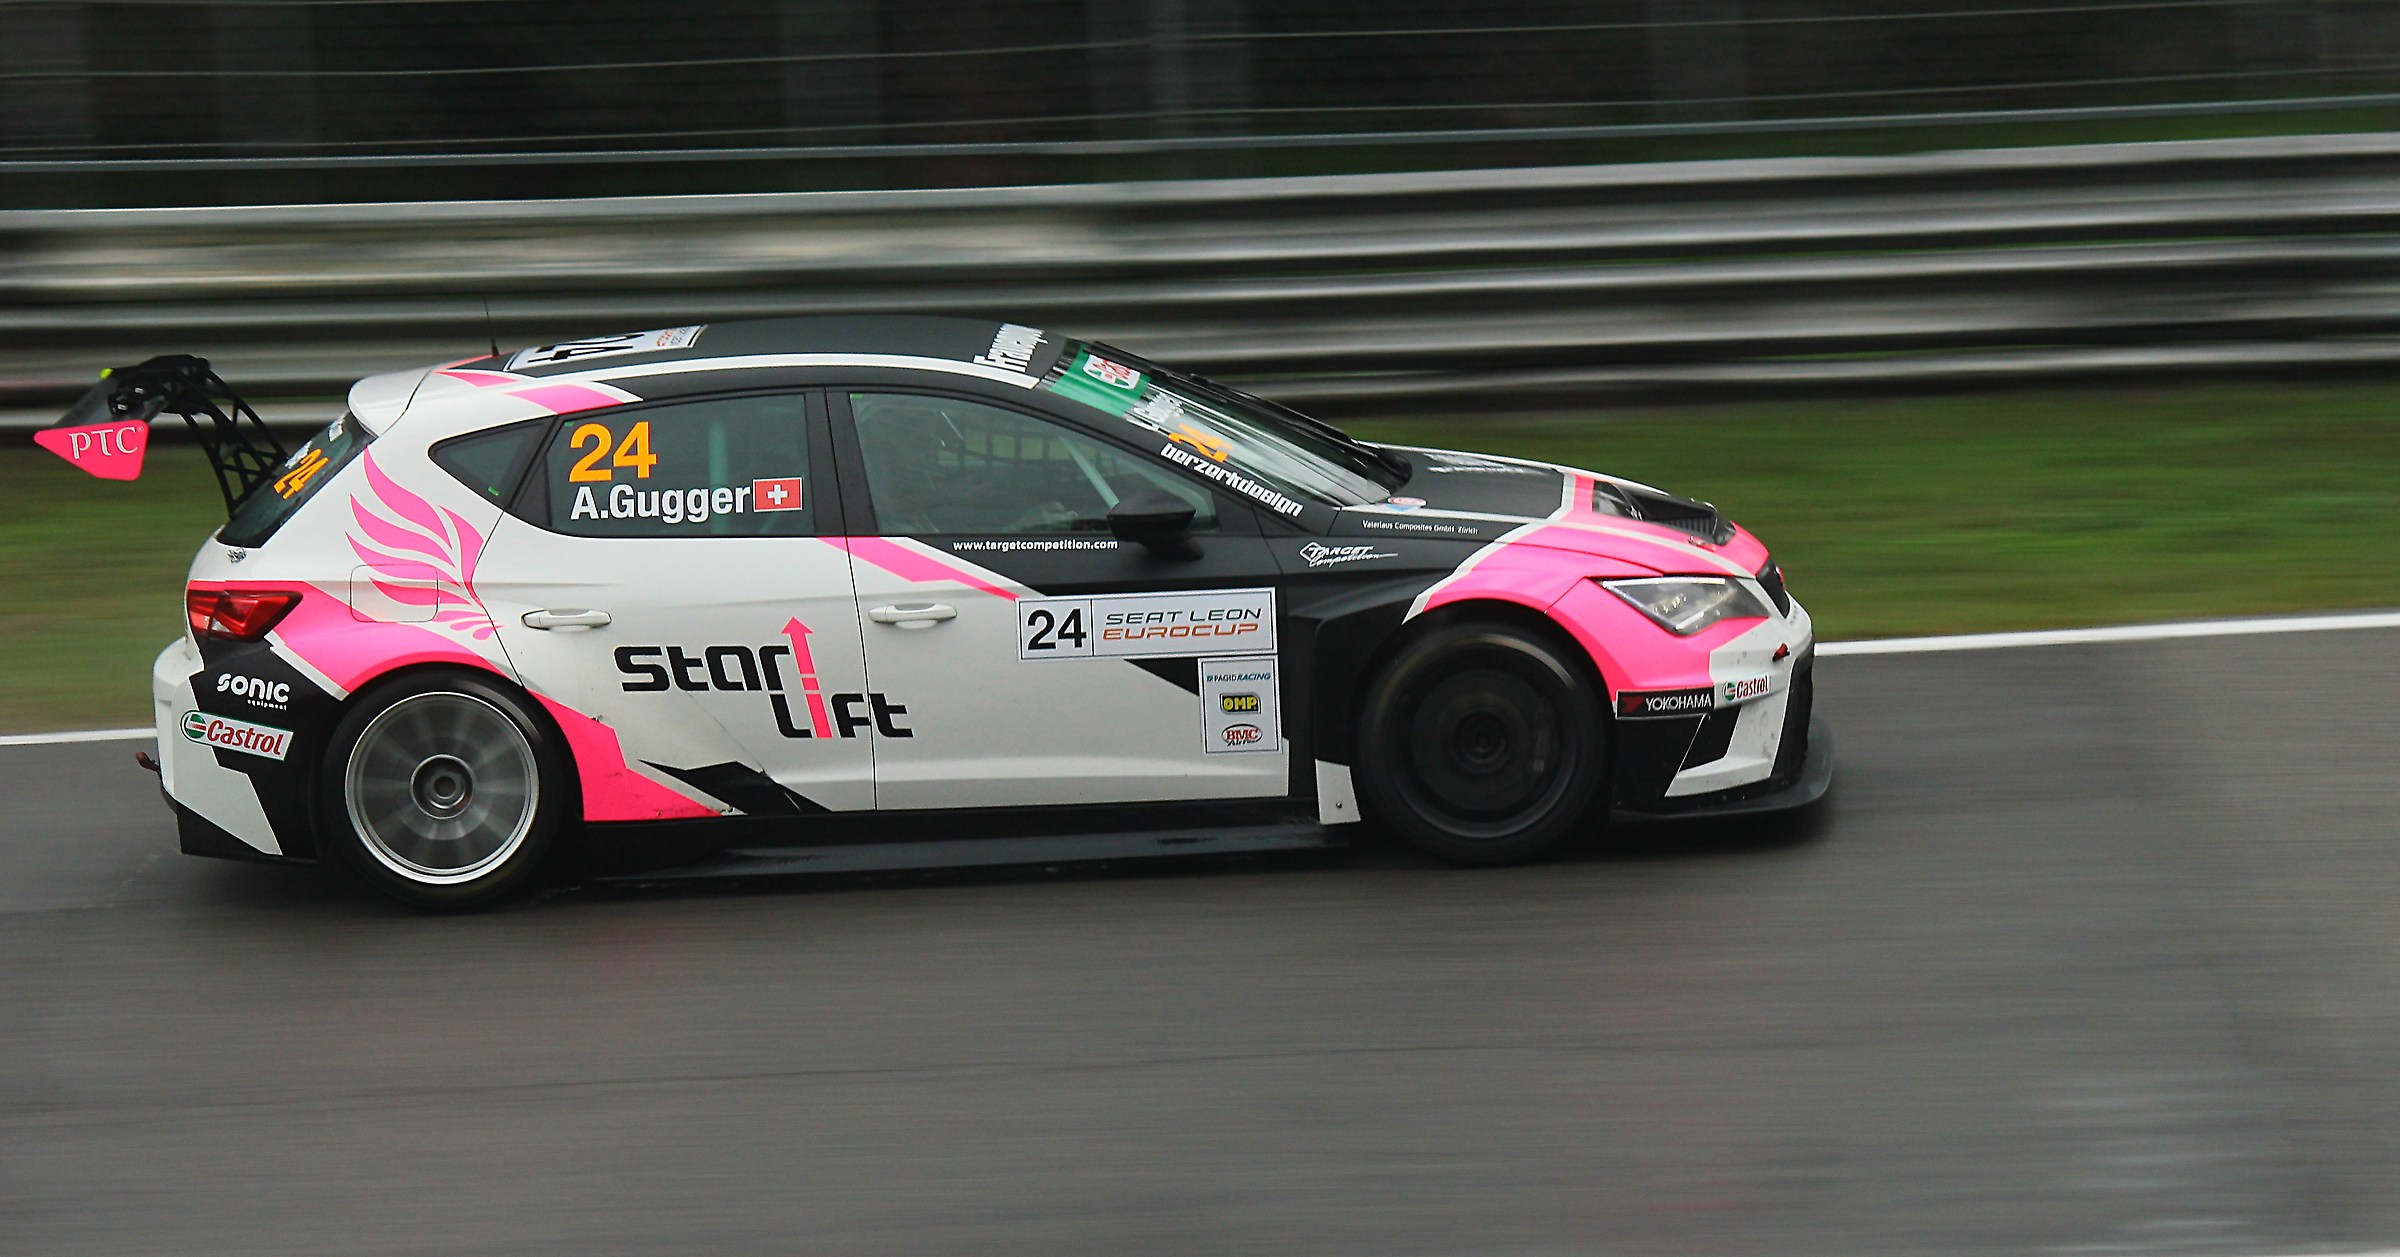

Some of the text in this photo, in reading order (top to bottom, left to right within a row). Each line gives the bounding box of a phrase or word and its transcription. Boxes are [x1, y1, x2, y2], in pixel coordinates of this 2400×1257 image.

[68, 426, 138, 460] PTC
[568, 421, 658, 483] 24
[273, 448, 330, 500] 24
[570, 483, 751, 524] A.Gugger
[1394, 521, 1432, 533] Composites
[1433, 523, 1455, 533] GmbH
[952, 538, 1118, 552] www.targetcompetition.com
[1106, 608, 1261, 625] SEAT LEON
[1027, 608, 1087, 651] 24
[1103, 623, 1259, 641] EUROCUP
[1736, 675, 1768, 699] Castrol
[247, 699, 287, 711] equipment
[1223, 697, 1257, 710] OMP
[1646, 693, 1712, 712] YOKOHAMA
[207, 720, 284, 755] Castrol
[1226, 729, 1259, 740] BMC
